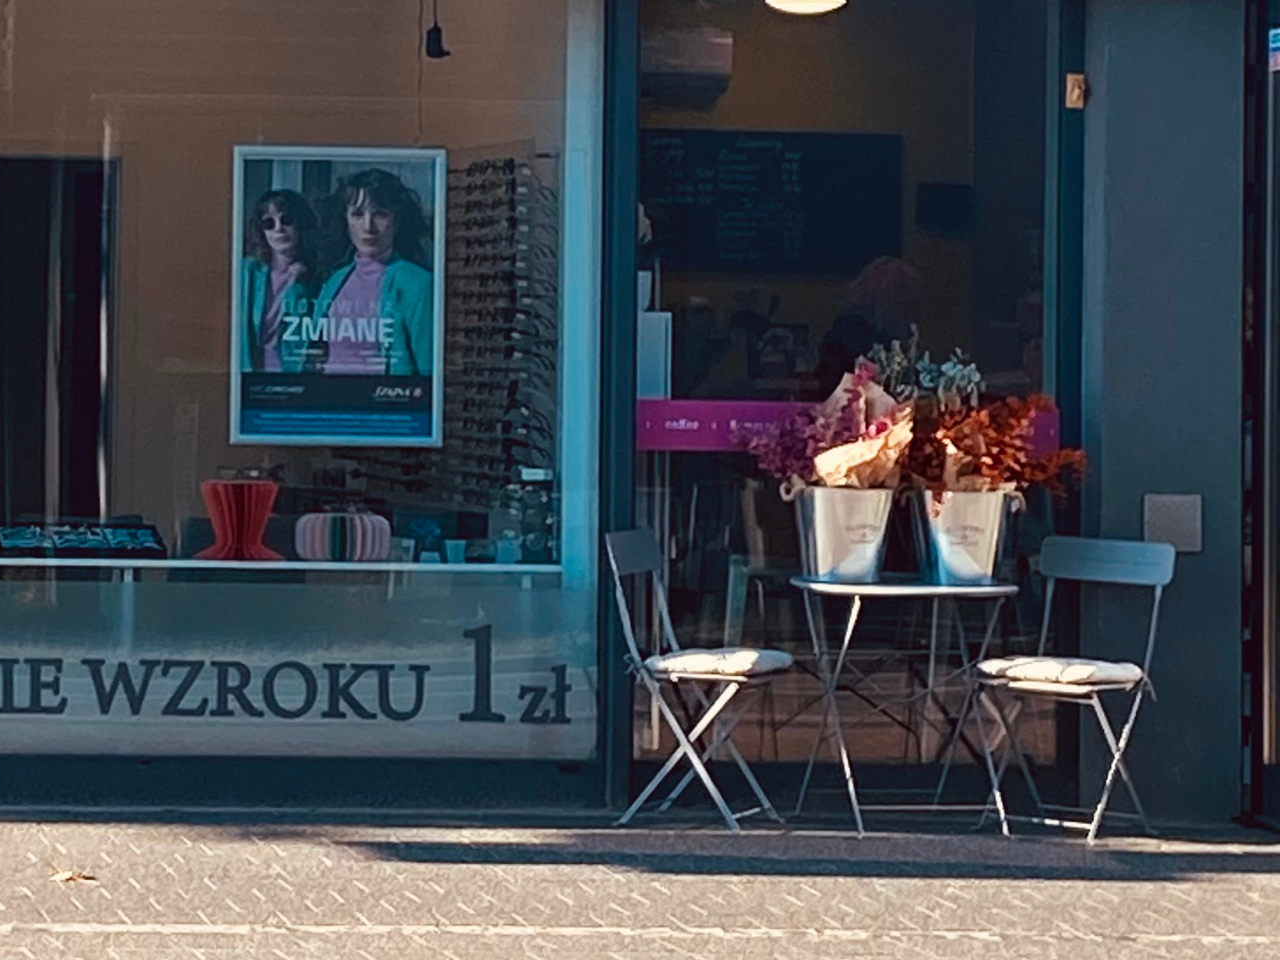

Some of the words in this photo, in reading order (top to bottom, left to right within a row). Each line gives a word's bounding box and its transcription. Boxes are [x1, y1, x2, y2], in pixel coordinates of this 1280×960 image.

[81, 657, 431, 722] WZROKU
[458, 624, 506, 724] 1
[517, 663, 572, 725] zł
